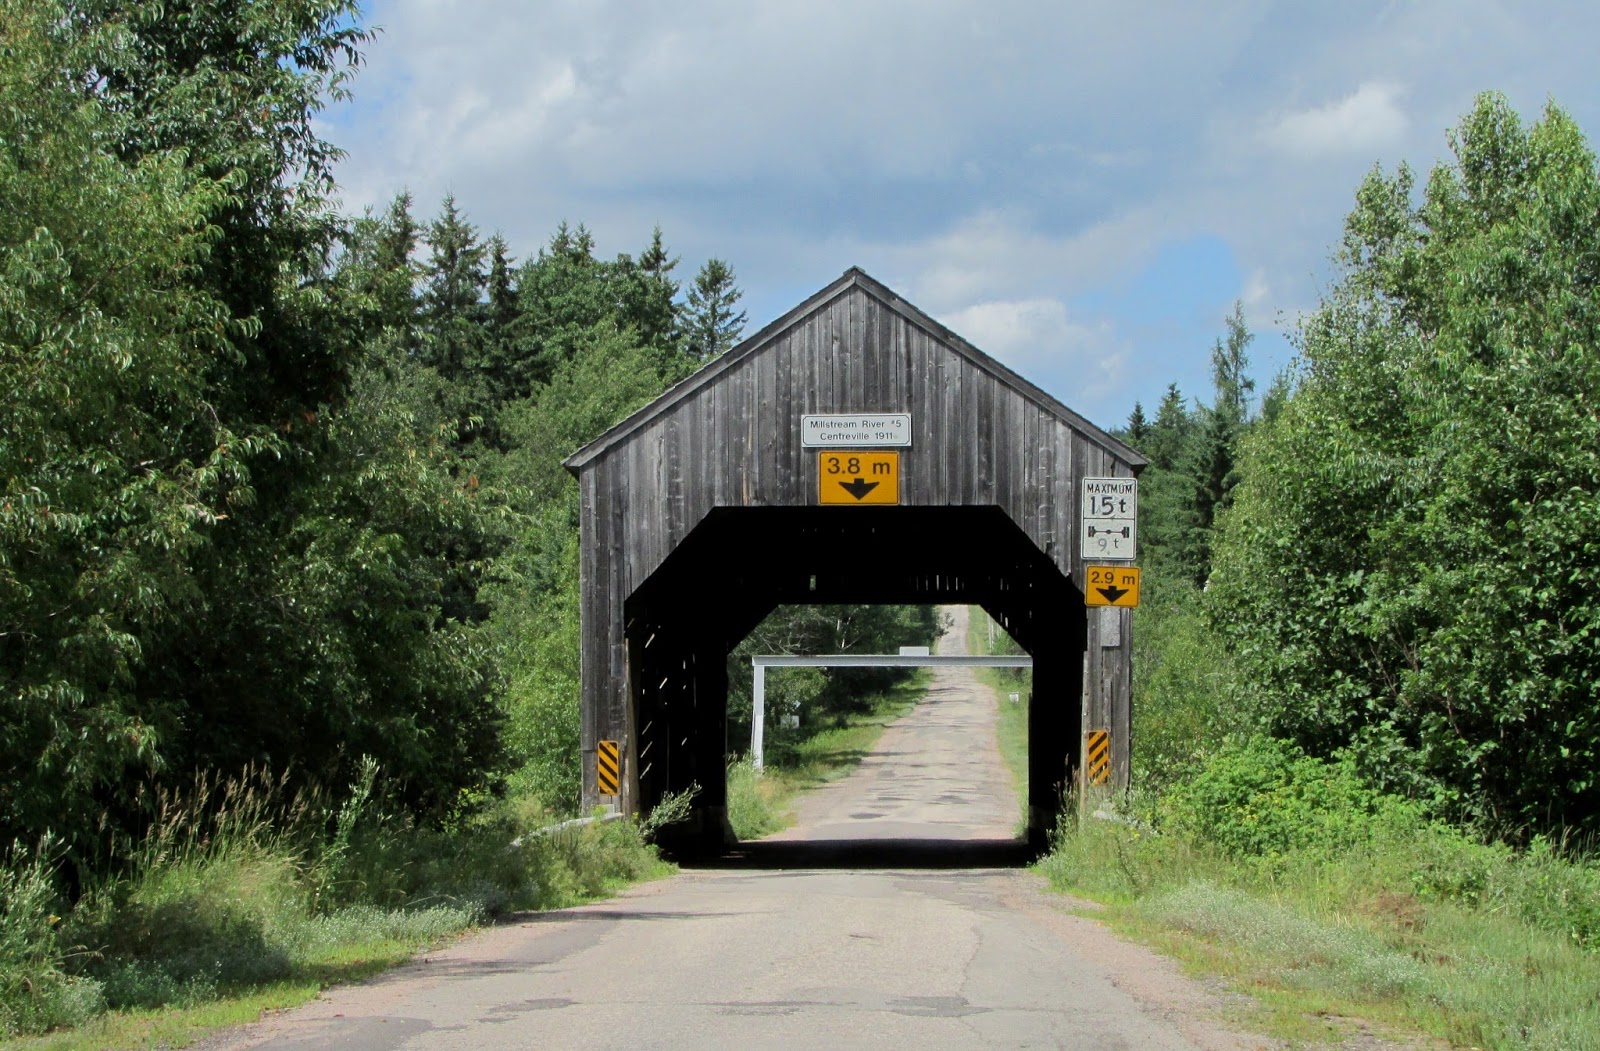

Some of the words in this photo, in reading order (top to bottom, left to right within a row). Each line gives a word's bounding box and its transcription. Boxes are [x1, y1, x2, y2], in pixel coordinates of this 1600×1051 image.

[810, 420, 857, 428] Millstream
[862, 420, 885, 428] River
[820, 432, 870, 440] Centreville
[875, 432, 893, 440] 1911
[828, 457, 861, 474] 3.8
[872, 462, 890, 475] m
[1087, 483, 1133, 495] MAXIMUM
[1090, 496, 1114, 515] 15
[1119, 499, 1126, 513] t
[1097, 538, 1108, 552] 9
[1113, 537, 1119, 549] t
[1091, 571, 1114, 584] 2.9
[1122, 574, 1135, 585] m
